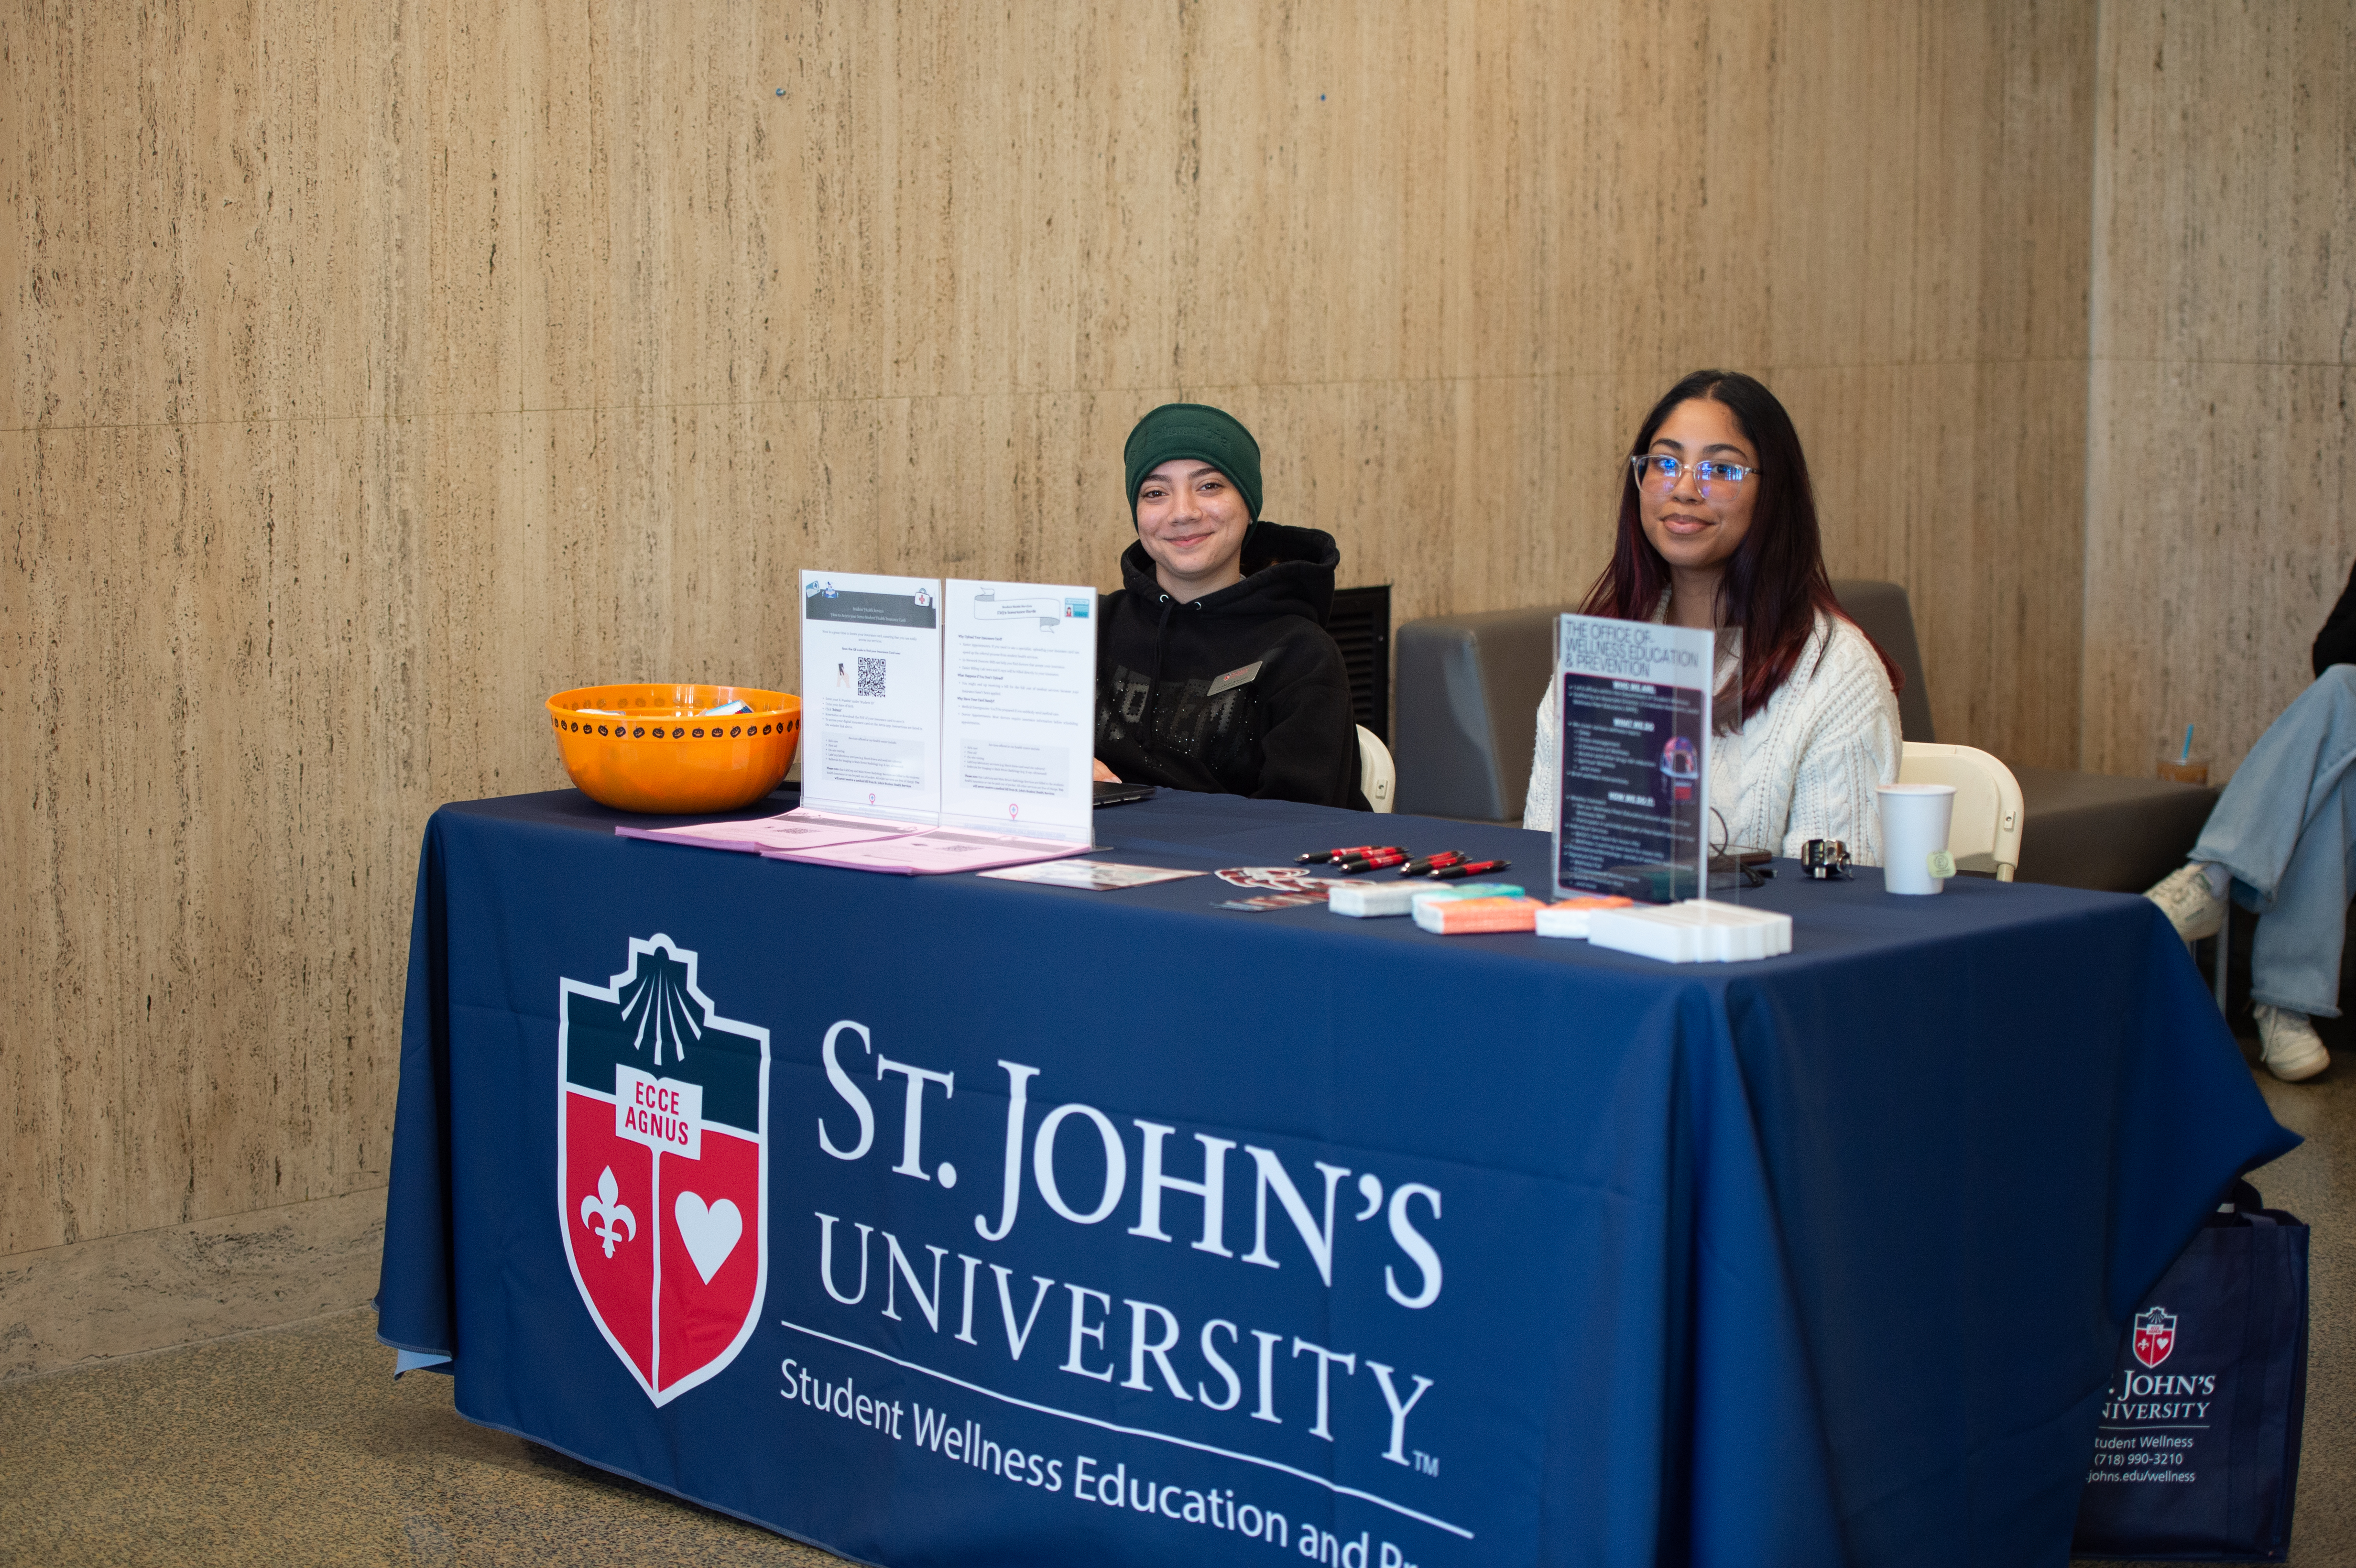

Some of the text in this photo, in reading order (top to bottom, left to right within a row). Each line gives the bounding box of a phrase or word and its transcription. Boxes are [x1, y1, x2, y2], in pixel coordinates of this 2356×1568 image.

[1566, 621, 1654, 645] THE OFFICE OF
[1565, 638, 1699, 668] WELLNESS EDUCATION
[1565, 652, 1650, 677] & PREVENTION
[635, 1080, 680, 1116] ECCE
[625, 1106, 689, 1146] AGNUS
[818, 1020, 1442, 1309] ST. JOHN'S
[814, 1211, 1433, 1467] UNIVERSITY
[2117, 1369, 2216, 1402] JOHN'S
[2102, 1402, 2211, 1420] NIVERSITY
[2094, 1435, 2194, 1449] tudent Wellness
[780, 1358, 904, 1441] Student
[913, 1403, 1063, 1492] Wellness
[1075, 1456, 1287, 1547] Education
[1298, 1523, 1369, 1568] and
[2094, 1452, 2183, 1467] (718) 990-3210
[2086, 1470, 2197, 1483] johns.edu/wellness
